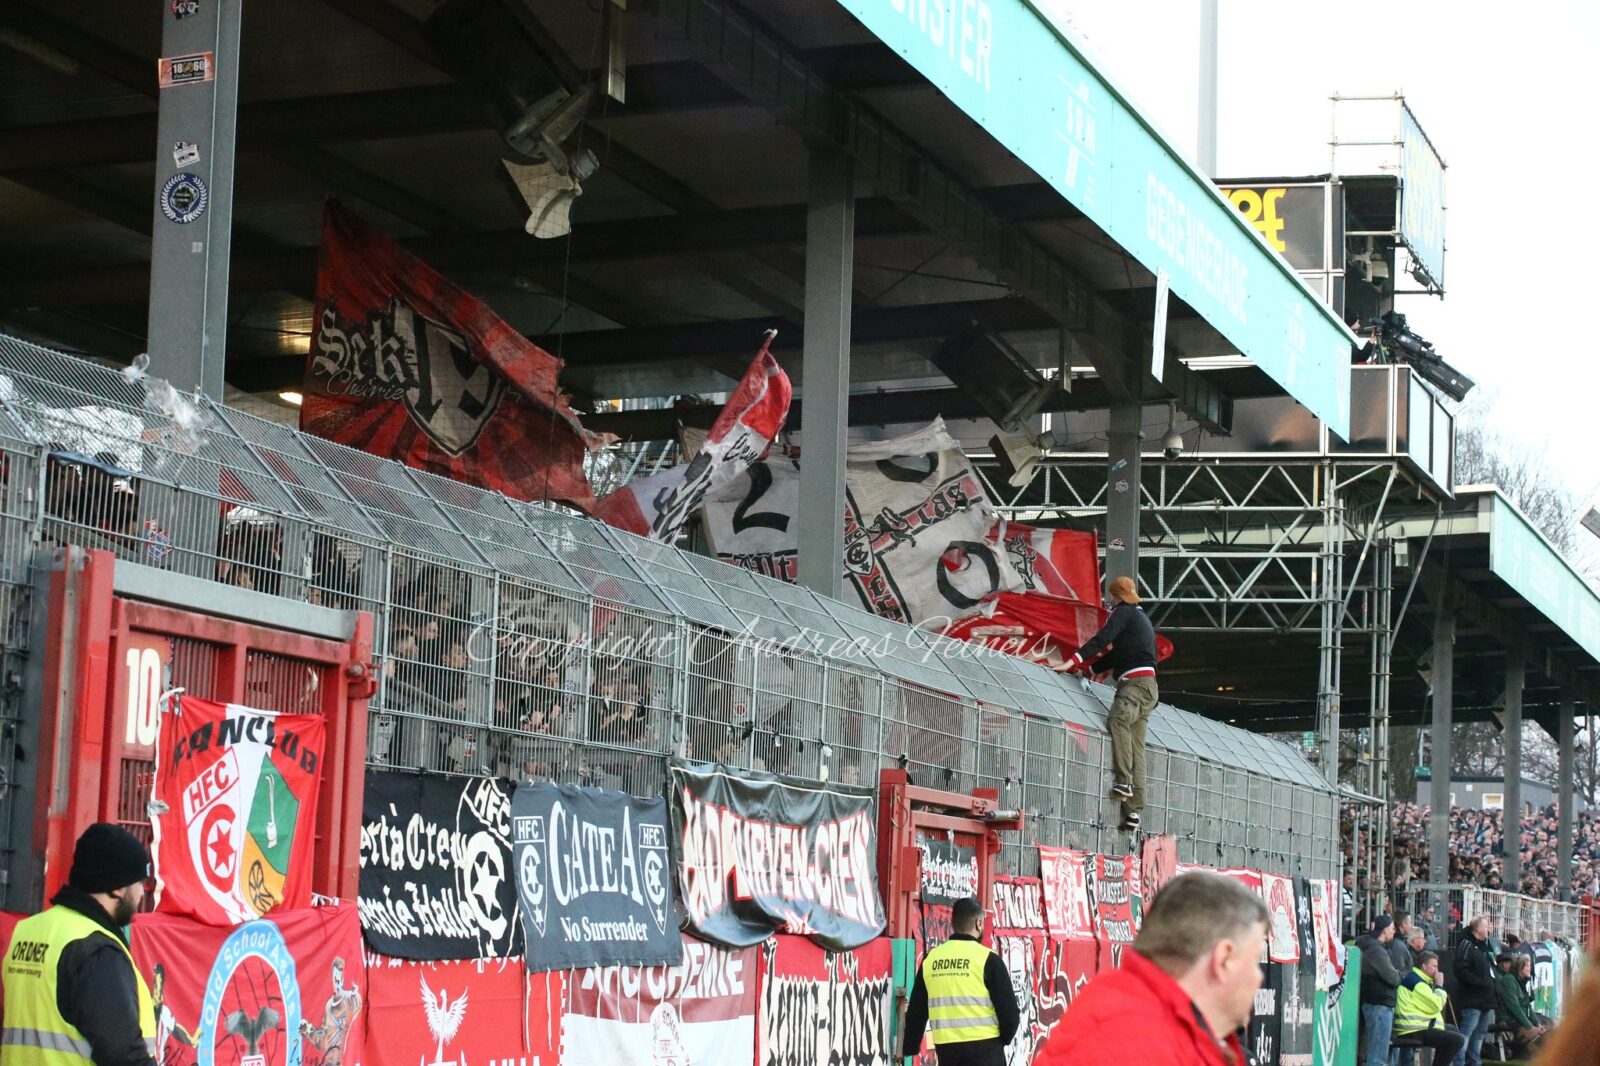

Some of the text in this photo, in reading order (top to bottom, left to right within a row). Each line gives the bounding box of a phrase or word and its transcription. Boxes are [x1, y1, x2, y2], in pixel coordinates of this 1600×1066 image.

[126, 648, 161, 746] 10
[174, 716, 318, 775] FANCLUB
[189, 760, 229, 815] HFC
[474, 778, 512, 838] HFC
[406, 812, 468, 871] Crew
[517, 819, 539, 840] HFC
[549, 800, 644, 906] GATE A
[643, 826, 660, 846] HFC
[405, 880, 480, 940] Halle
[560, 914, 649, 942] No Surrender
[11, 940, 50, 964] ORDNER
[203, 969, 224, 1026] Old
[223, 931, 272, 970] School
[932, 957, 970, 971] ORDNER
